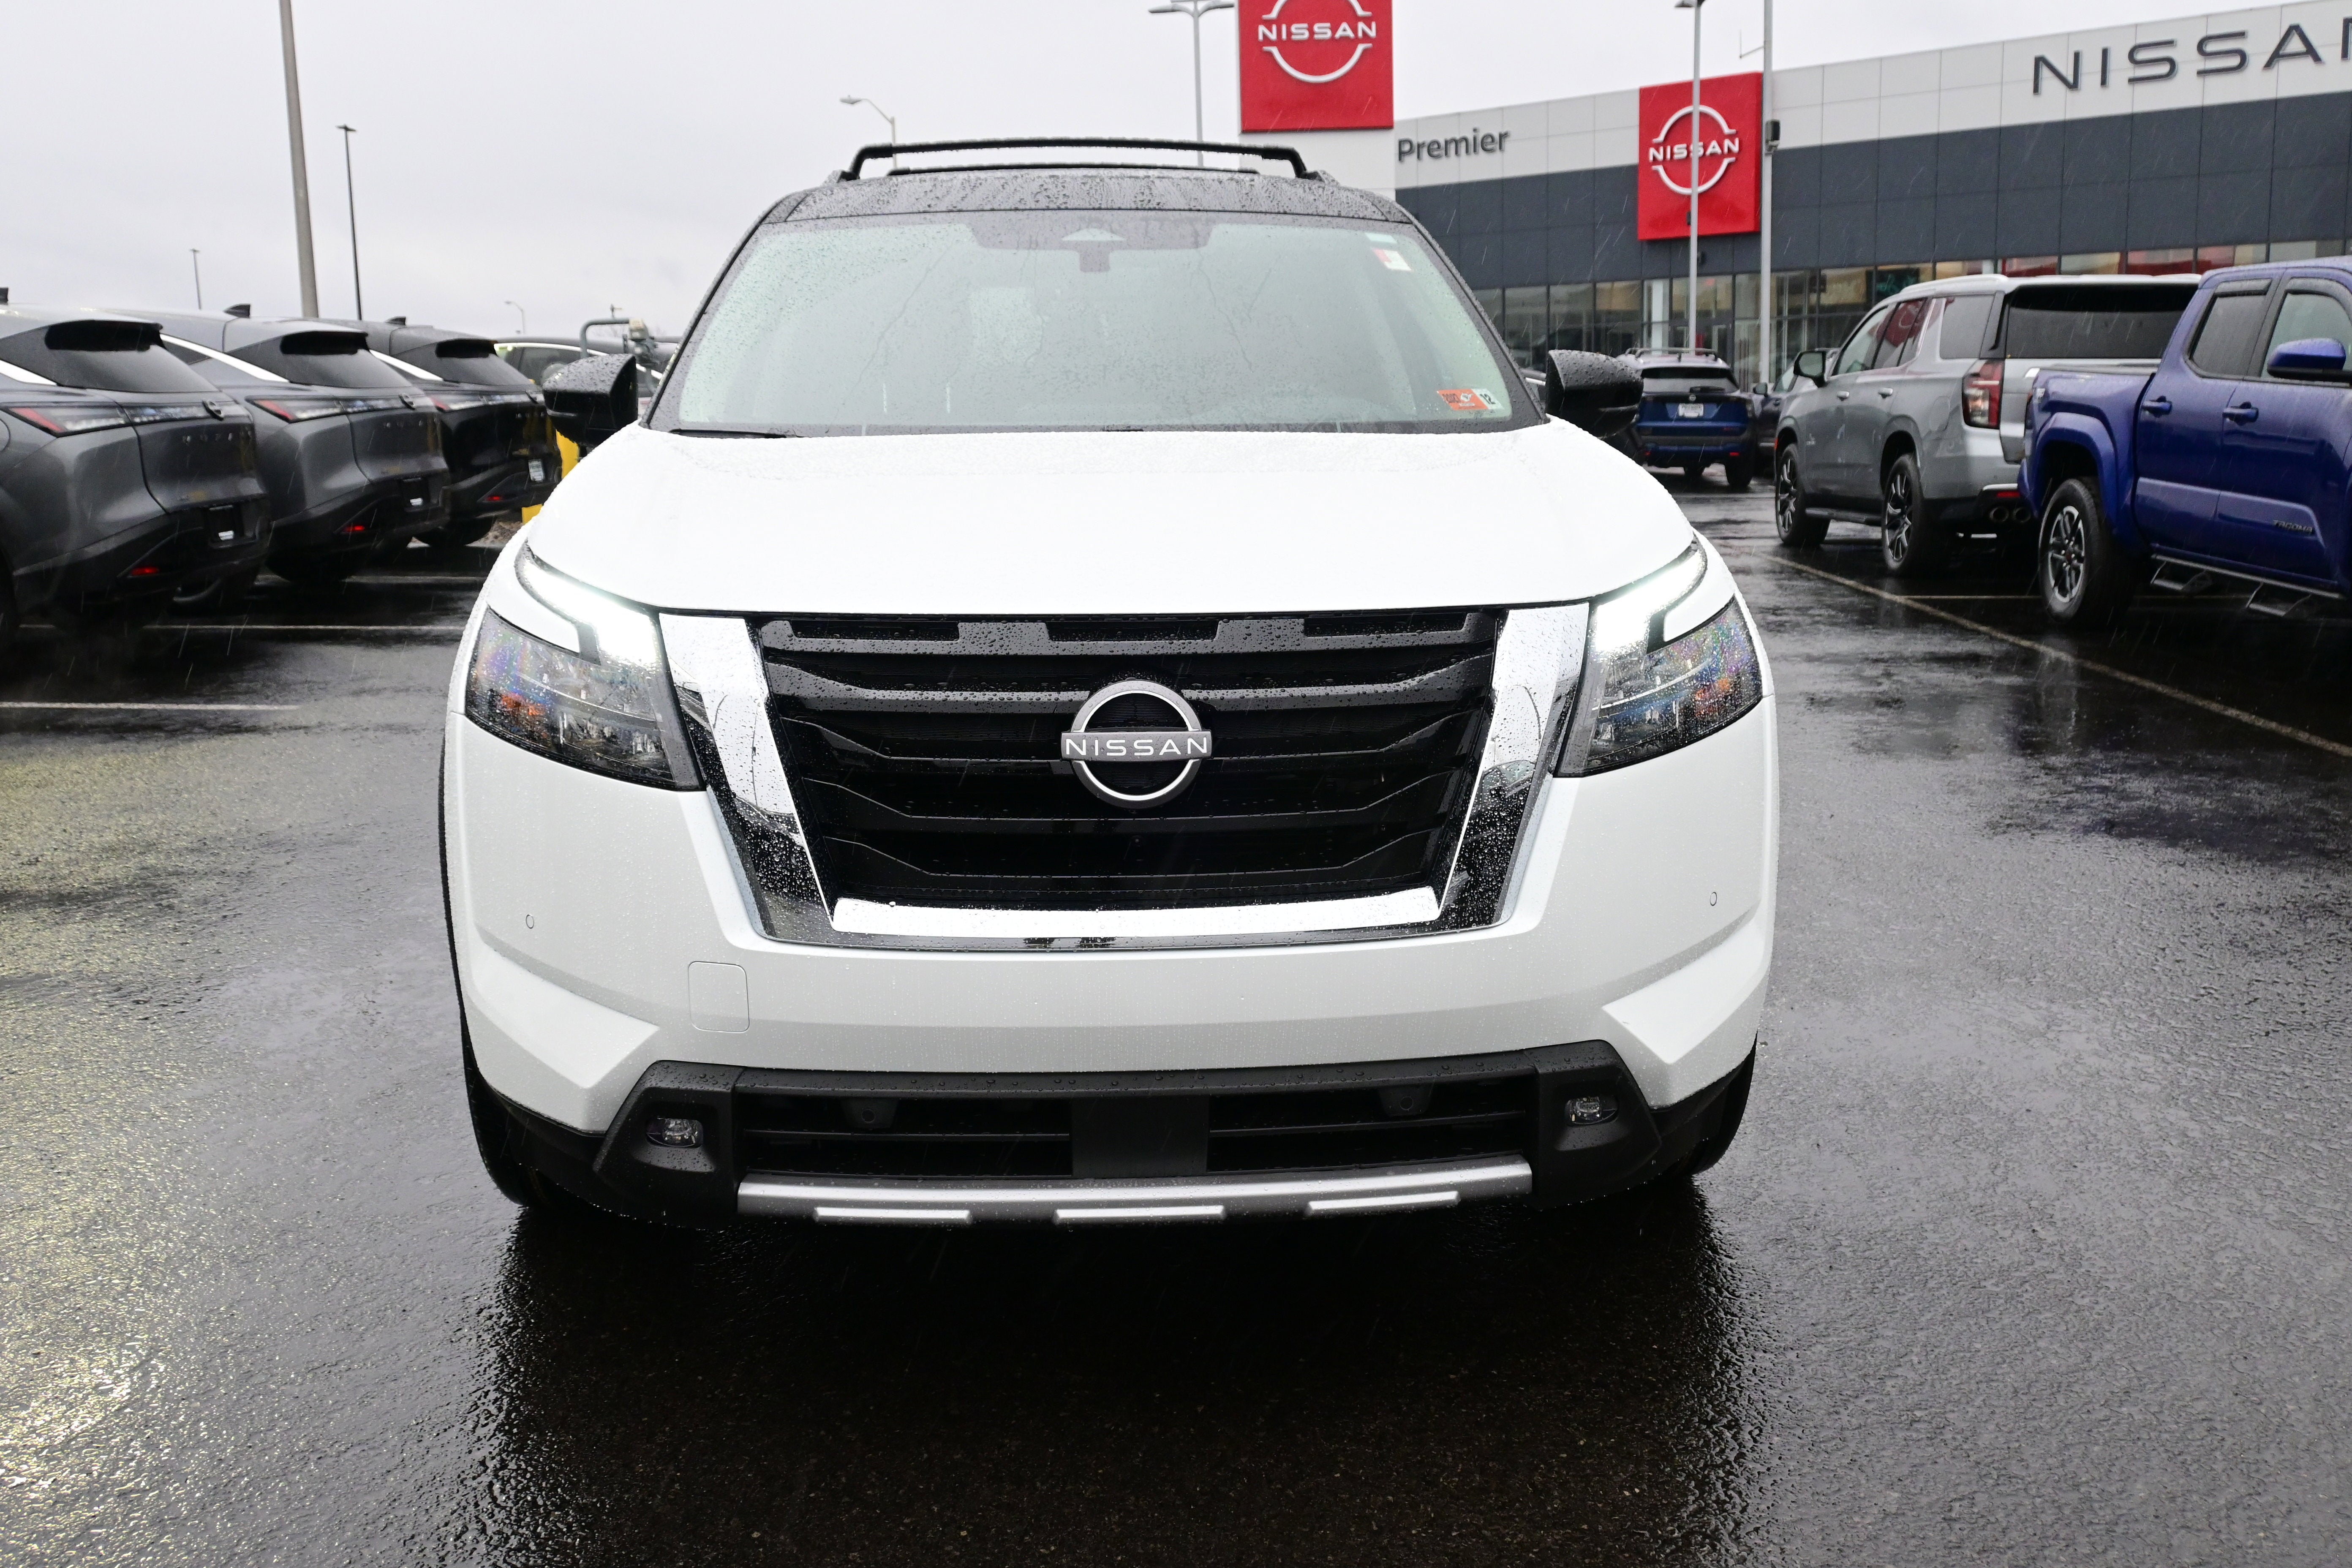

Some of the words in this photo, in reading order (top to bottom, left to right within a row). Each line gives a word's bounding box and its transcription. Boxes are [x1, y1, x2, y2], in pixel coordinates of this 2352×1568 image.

[1258, 21, 1377, 41] NISSAN
[1398, 127, 1510, 163] Premier
[1480, 393, 1496, 405] 12
[2273, 520, 2313, 533] TACOMA
[1065, 737, 1207, 756] NISSAN
